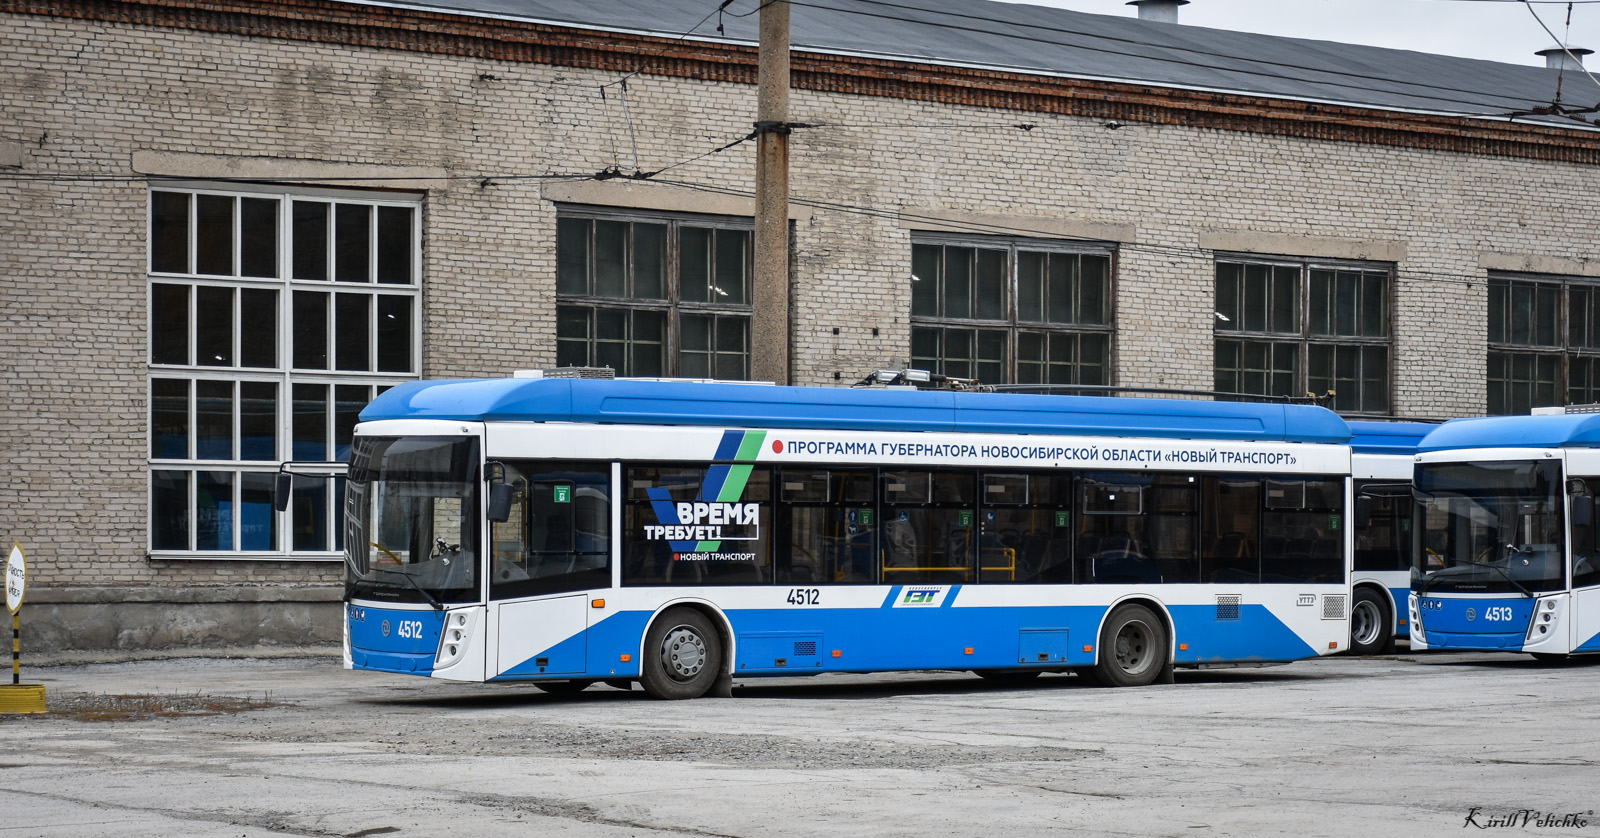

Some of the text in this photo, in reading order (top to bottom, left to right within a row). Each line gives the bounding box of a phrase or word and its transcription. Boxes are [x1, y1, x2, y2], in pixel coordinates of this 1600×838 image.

[787, 441, 1297, 465] ПРОГРАММА ГУБЕРНАТОРА НОВОСИБИРСКОЙ ОБЛАСТИ «НОВЫЙ ТРАНСПОРТ»
[677, 502, 760, 525] ВРЕМЯ
[644, 525, 722, 540] ТРЕБУЕТ!
[680, 552, 756, 561] НОВЫЙ ТРАНСПОРТ
[786, 588, 820, 605] 4512
[1484, 607, 1513, 621] 4513
[397, 620, 423, 639] 4512
